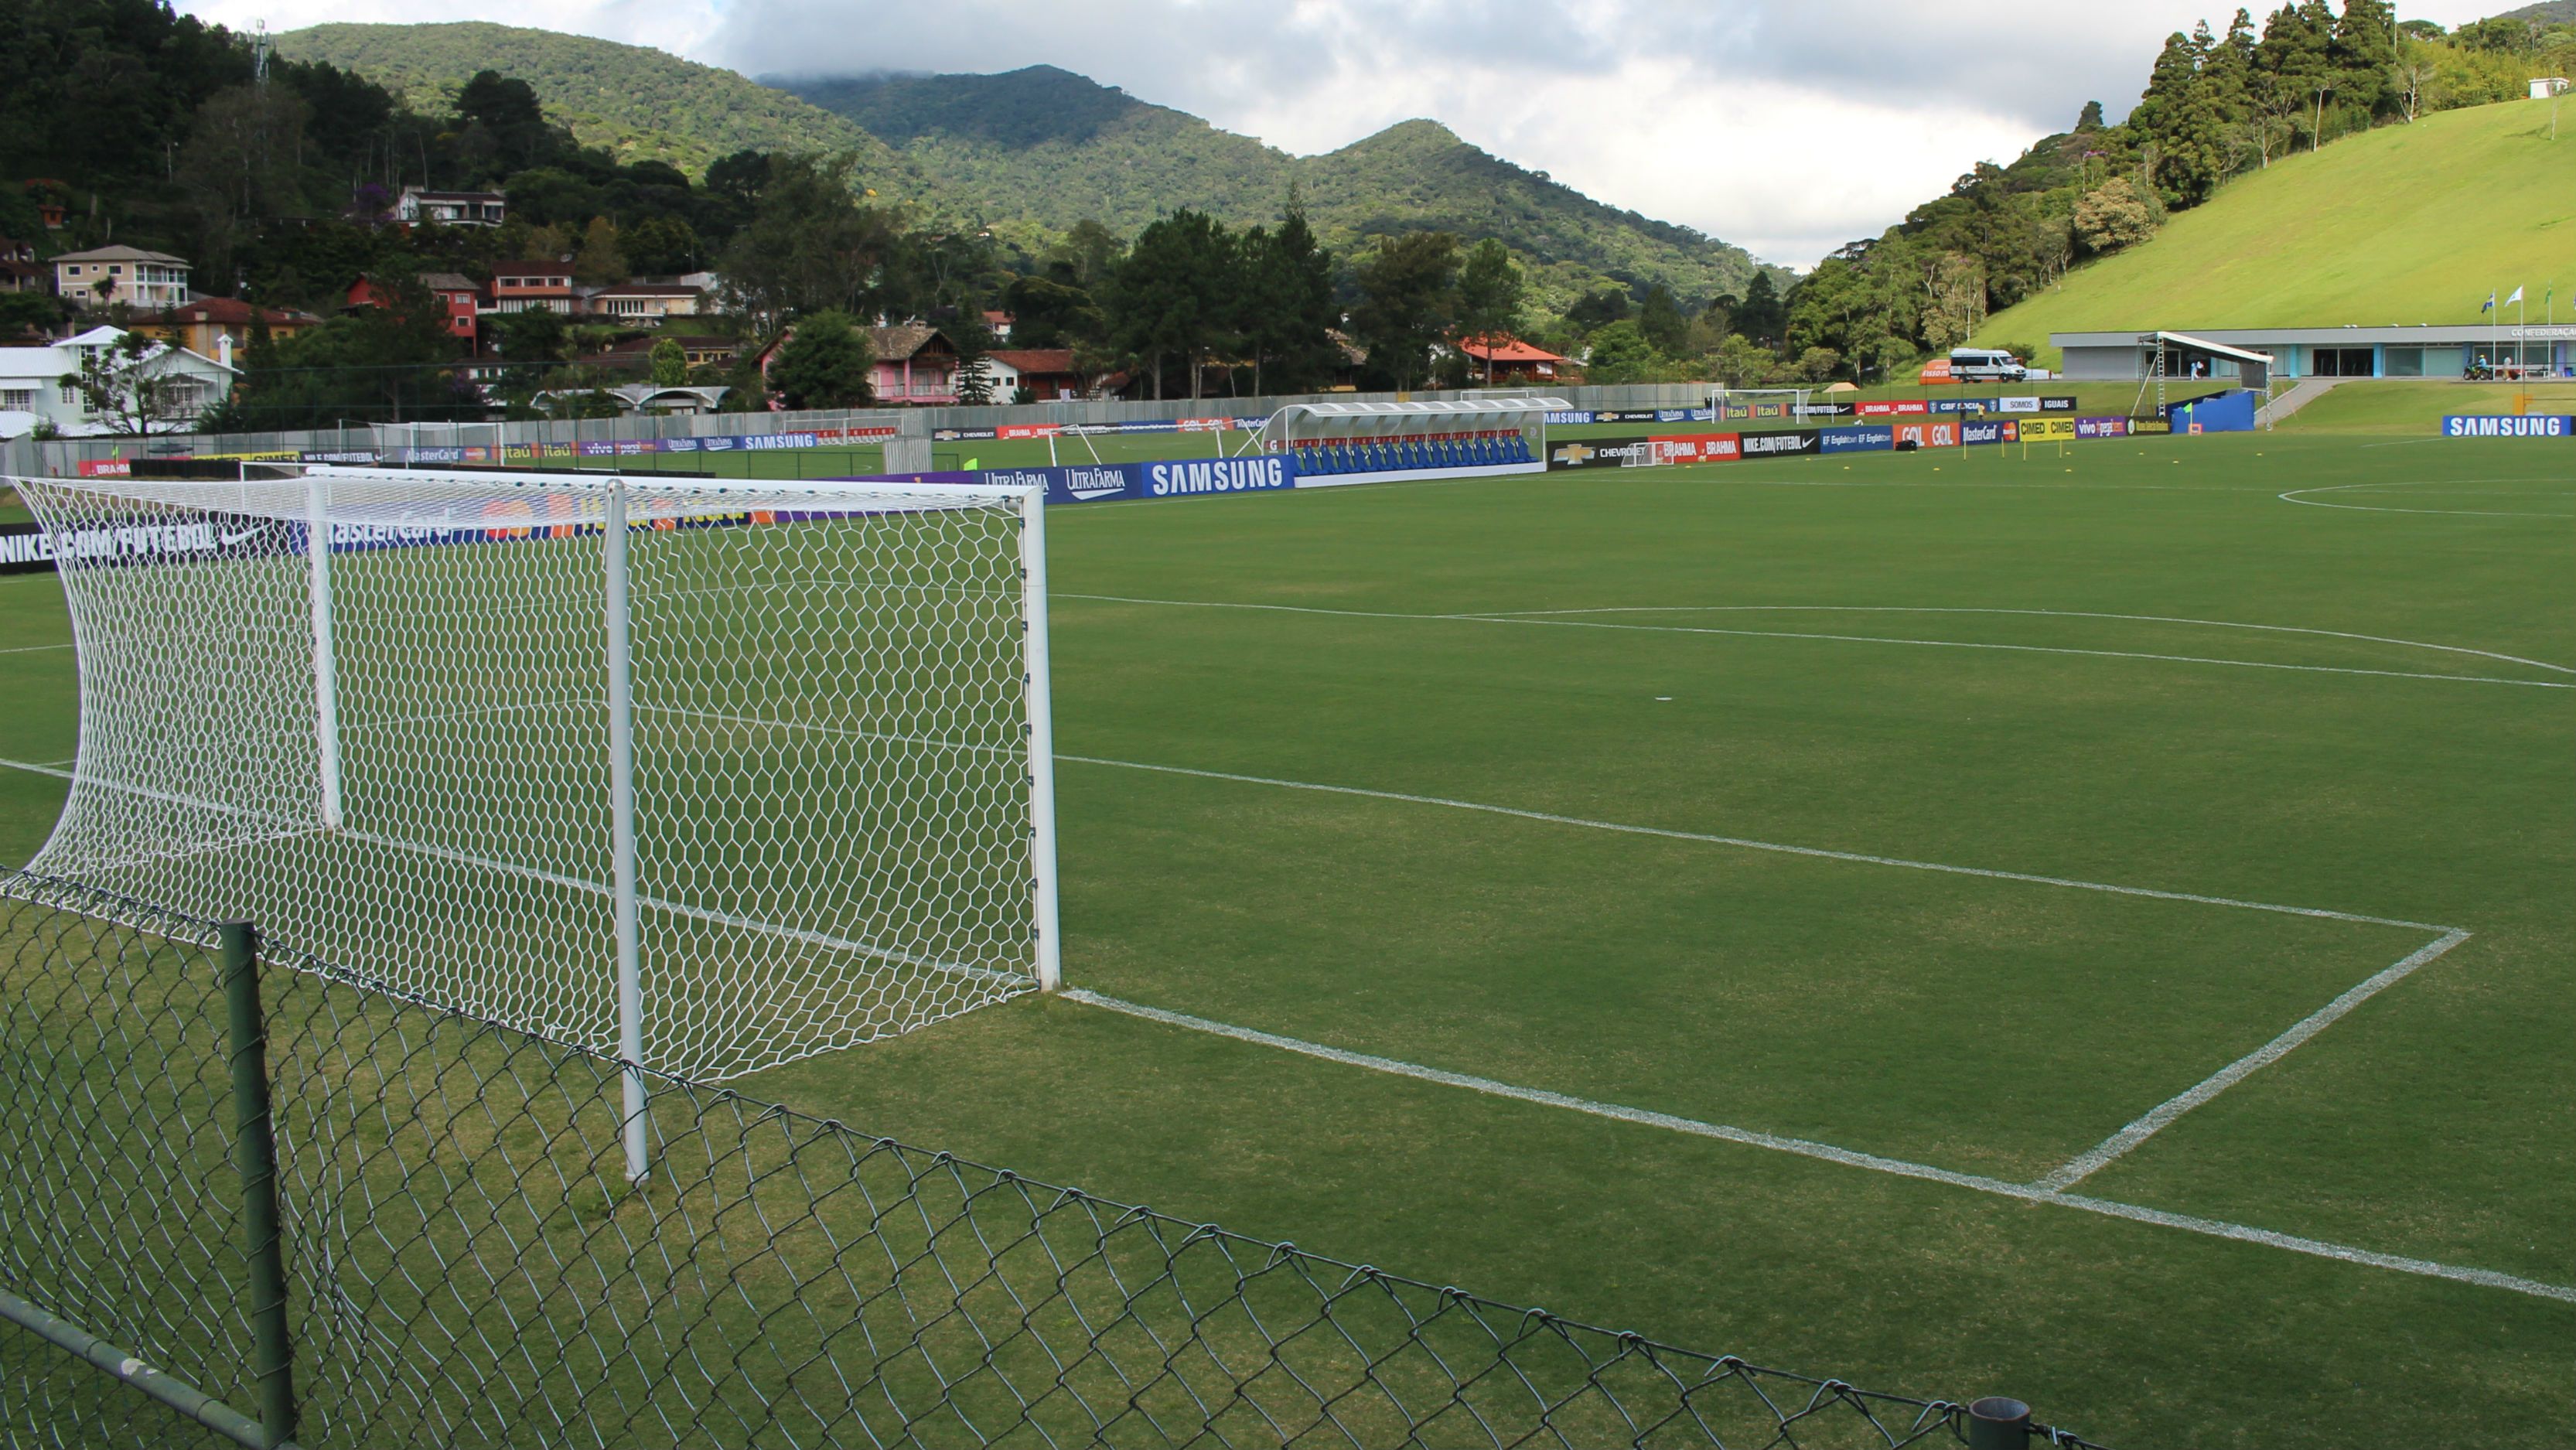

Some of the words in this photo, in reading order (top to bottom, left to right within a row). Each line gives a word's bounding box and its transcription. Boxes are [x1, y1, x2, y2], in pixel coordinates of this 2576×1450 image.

[2512, 327, 2576, 338] CONFEDERAÇÃ
[1898, 404, 1924, 412] BRAHMA
[2010, 401, 2033, 409] SOMOS
[2045, 400, 2069, 408] IGUAIS
[1544, 411, 1590, 424] AMSUNG
[2021, 421, 2045, 435] CIMED
[2051, 421, 2074, 433] CIMED
[2079, 419, 2096, 435] vivo
[2450, 418, 2560, 435] SAMSUNG
[1932, 425, 1953, 445] GOL
[1963, 425, 1997, 442] MasterCard
[588, 442, 613, 454] vivo
[746, 434, 813, 449] SAMSUNG
[1706, 441, 1737, 455] BRAHMA
[97, 463, 130, 475] BRAHM
[1152, 458, 1283, 496] SAMSUNG
